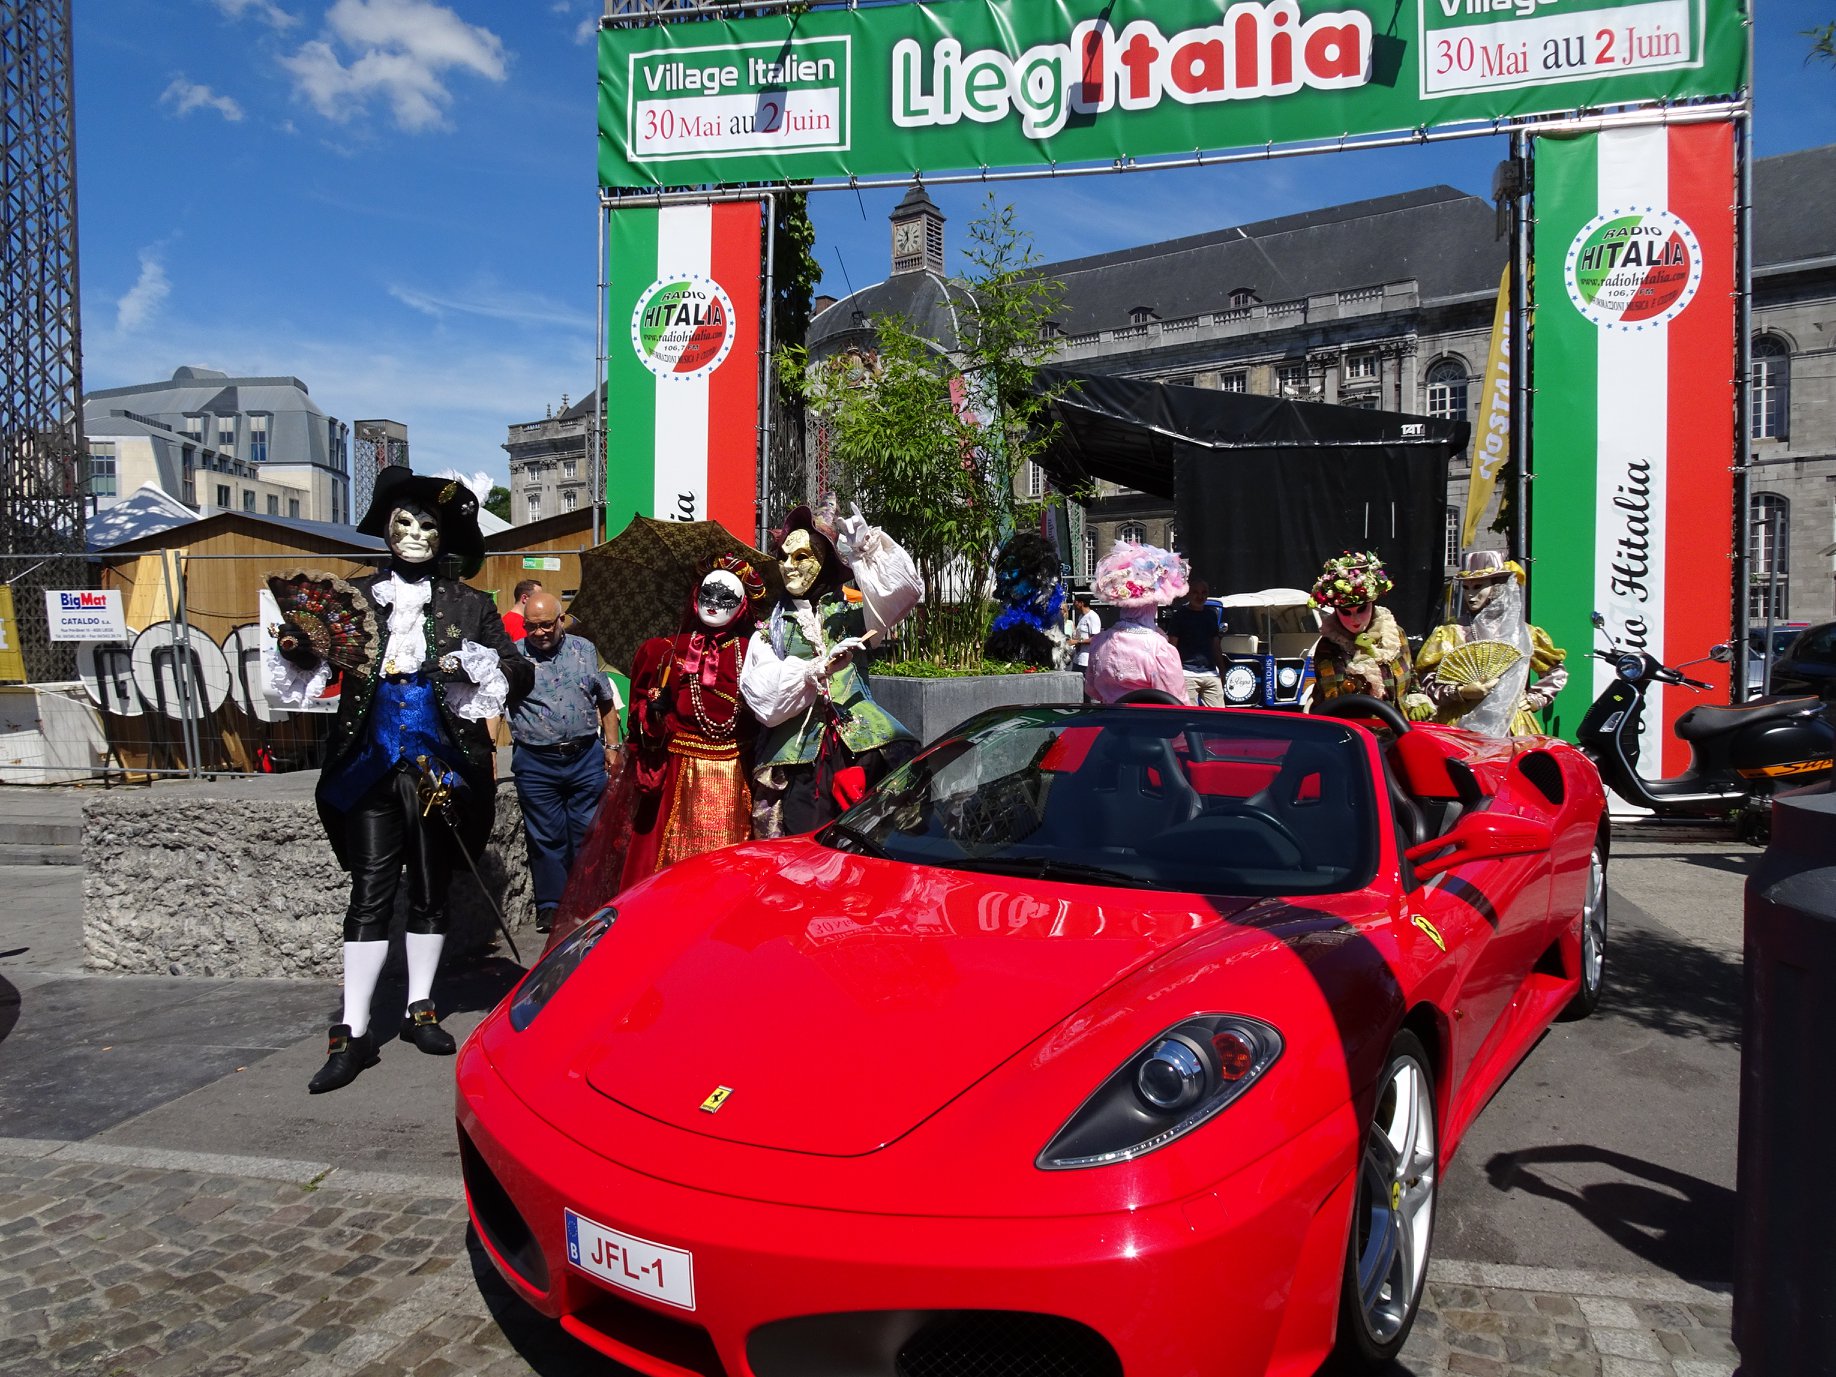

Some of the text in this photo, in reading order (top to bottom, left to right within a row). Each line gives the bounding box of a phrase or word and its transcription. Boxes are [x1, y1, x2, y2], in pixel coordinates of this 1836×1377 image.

[1436, 25, 1681, 78] 30 Mai au 2 Juin
[643, 54, 835, 95] Village Italien
[893, 2, 1373, 138] LiegItalia
[644, 102, 831, 140] 30 Mai au 2 Juin
[1603, 226, 1662, 240] RADIO
[1581, 241, 1684, 271] HITALIA
[1580, 270, 1686, 287] www.radiohitalia.com
[662, 290, 706, 301] RADIO
[1608, 289, 1636, 297] 106,7
[644, 303, 722, 328] HITALIA
[1611, 458, 1651, 603] Hitalia
[60, 592, 107, 610] BigMat
[61, 617, 100, 625] CATALDO
[570, 1237, 664, 1288] B JFL-1
